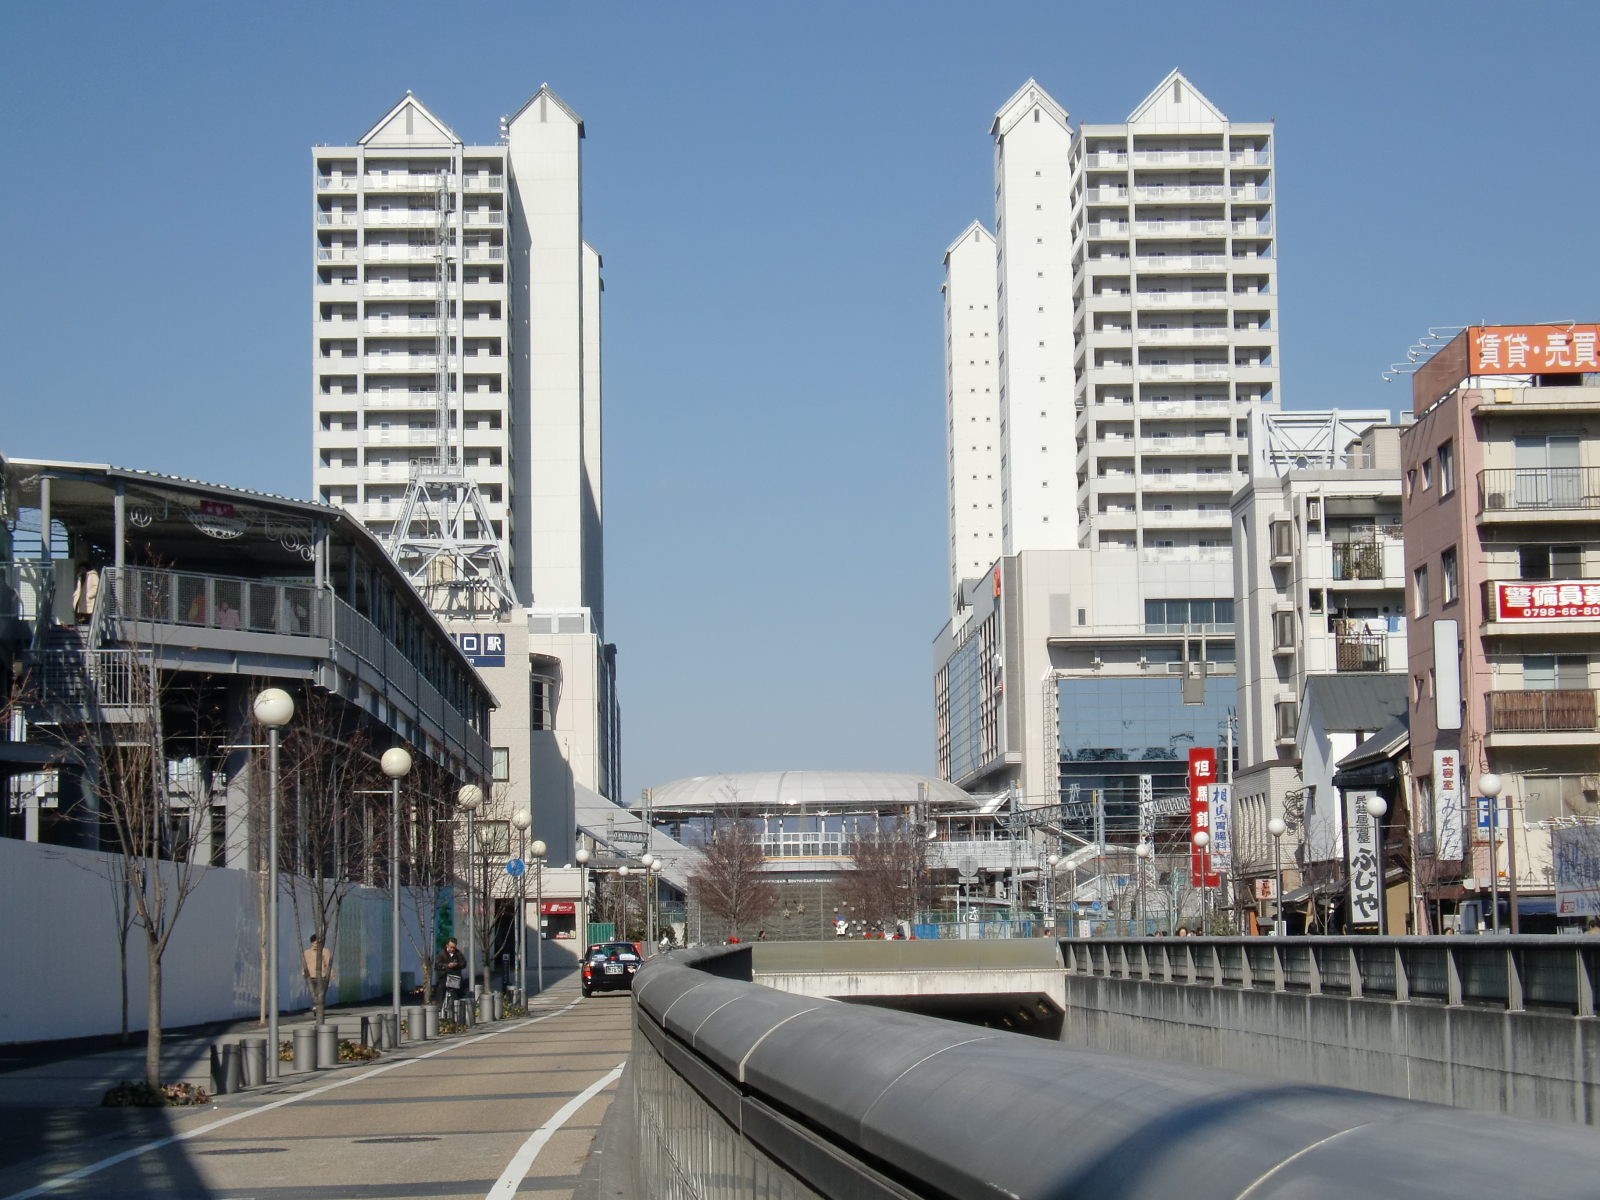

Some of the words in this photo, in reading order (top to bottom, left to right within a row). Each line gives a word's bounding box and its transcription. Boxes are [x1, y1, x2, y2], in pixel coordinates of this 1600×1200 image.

[1475, 332, 1597, 370] 賃貸・売買
[1442, 756, 1454, 791] 美容室
[1212, 787, 1228, 851] 相馬胃腸科
[1351, 847, 1379, 919] ふじや
